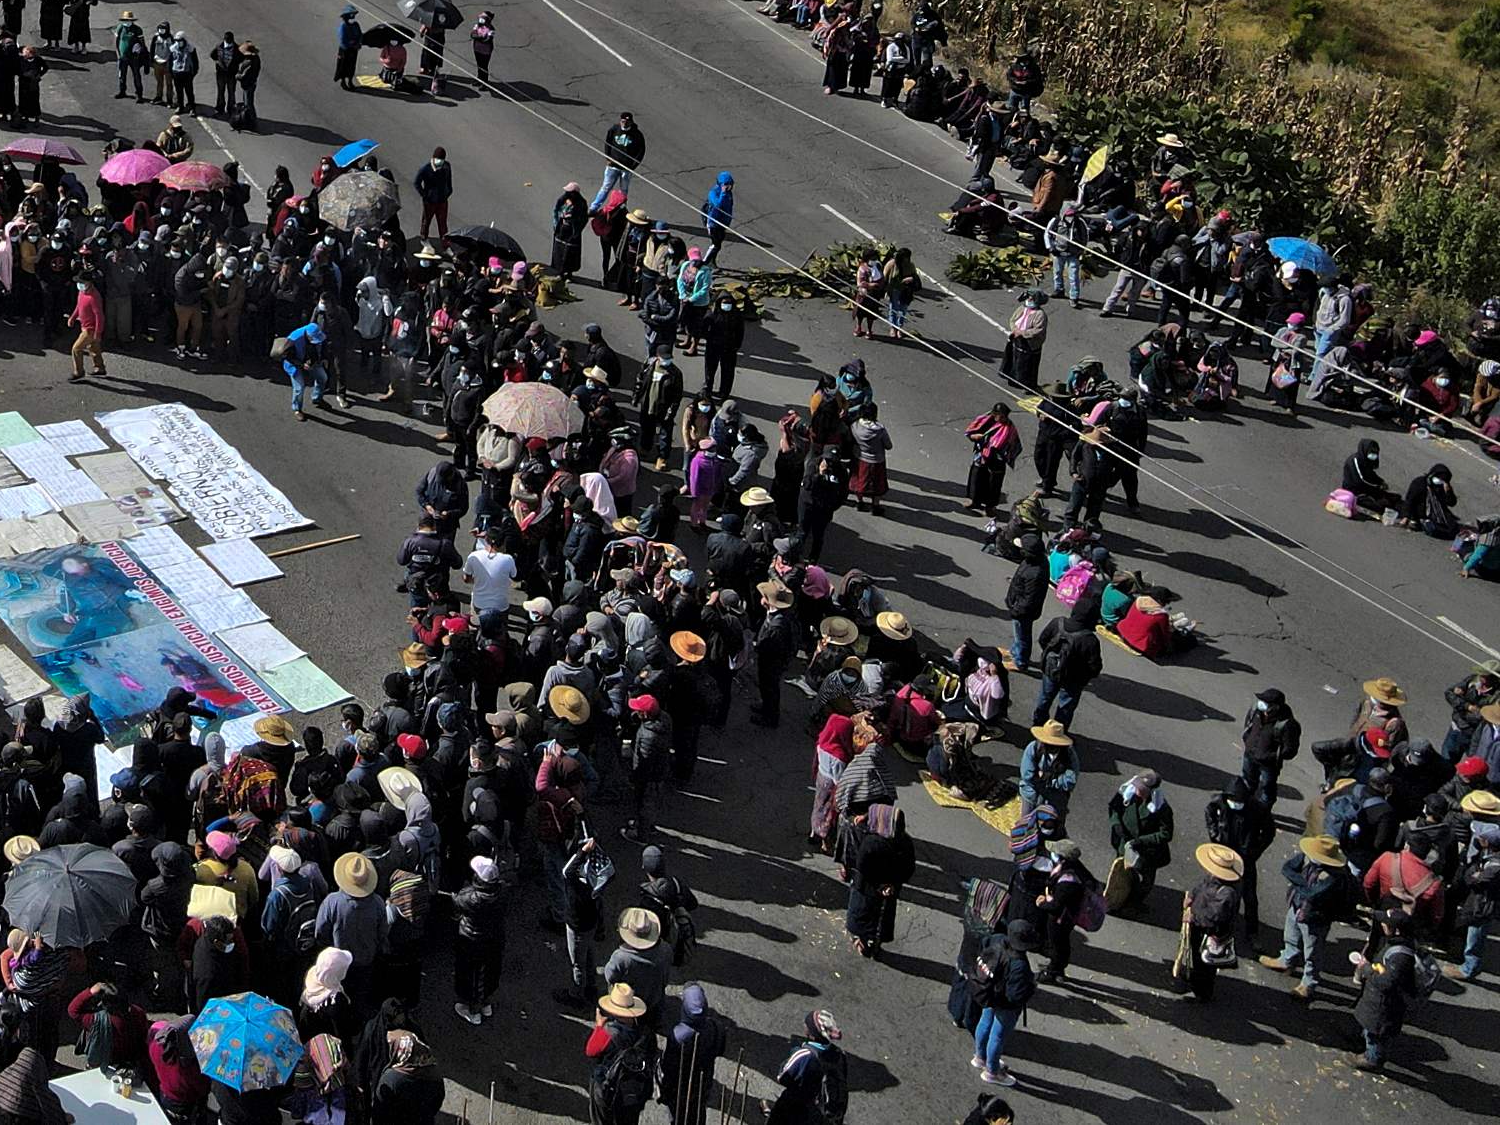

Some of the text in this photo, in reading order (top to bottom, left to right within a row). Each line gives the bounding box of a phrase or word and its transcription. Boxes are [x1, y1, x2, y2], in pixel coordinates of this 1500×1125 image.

[177, 470, 255, 534] GOBIERNO
[101, 541, 146, 578] JUSTICIA
[135, 579, 184, 620] EXIGIMOS
[176, 621, 228, 664] JUSTICIA!
